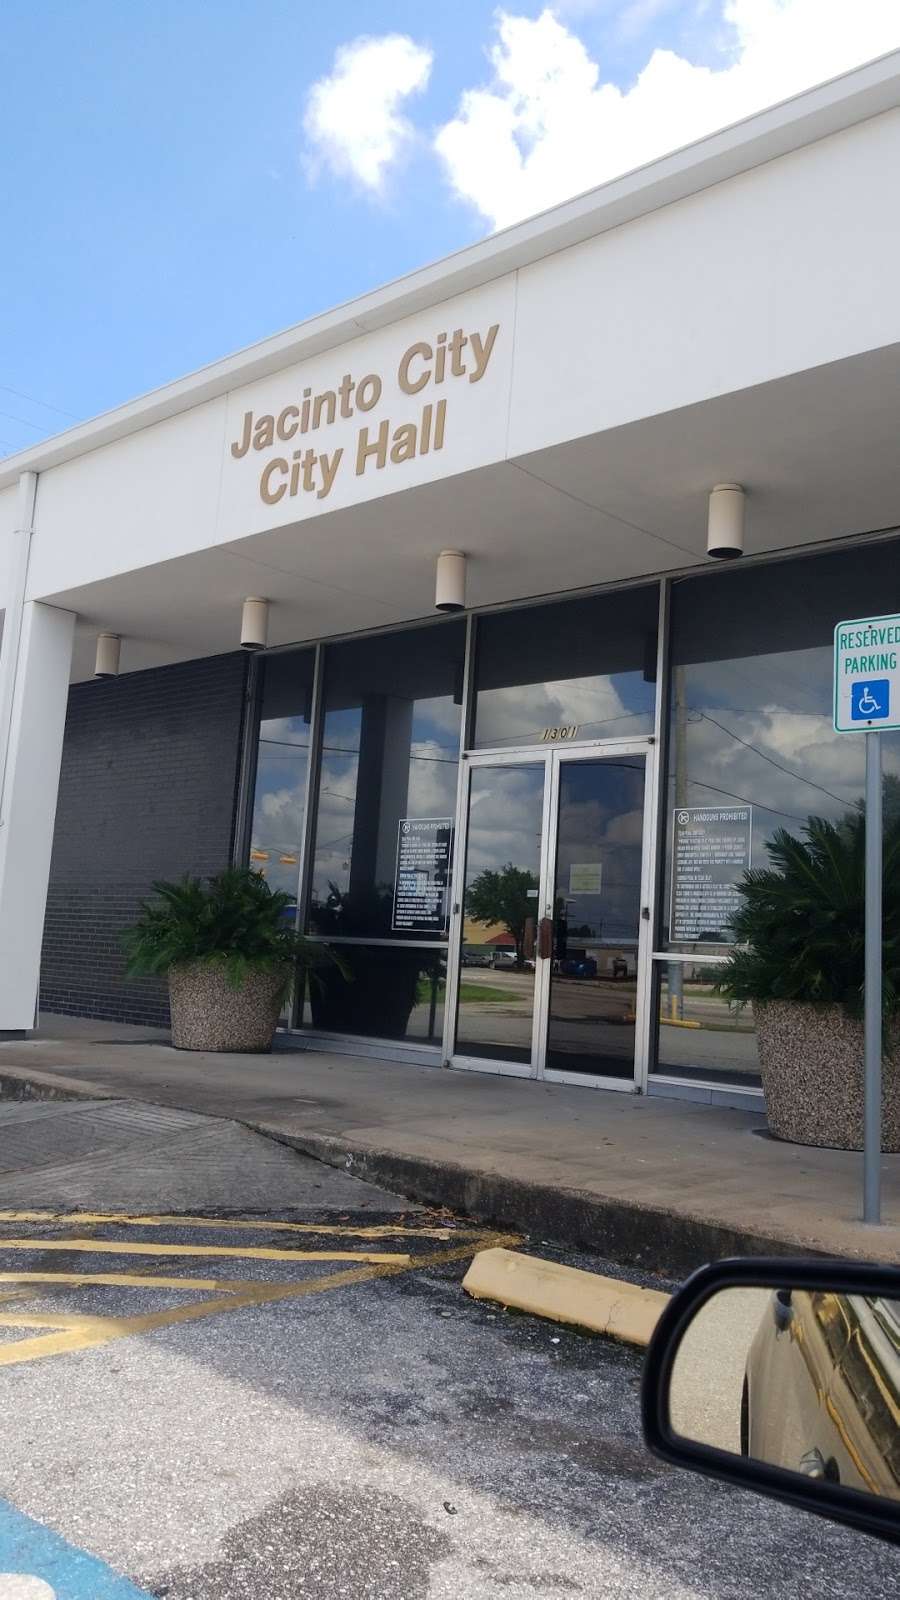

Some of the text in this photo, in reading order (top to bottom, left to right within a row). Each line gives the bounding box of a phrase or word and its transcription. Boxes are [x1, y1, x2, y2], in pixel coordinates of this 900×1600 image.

[231, 324, 500, 458] Jacinto City
[259, 399, 447, 505] City Hall
[840, 627, 900, 649] RESERVED
[845, 653, 897, 674] PARKING
[543, 725, 577, 740] 1301
